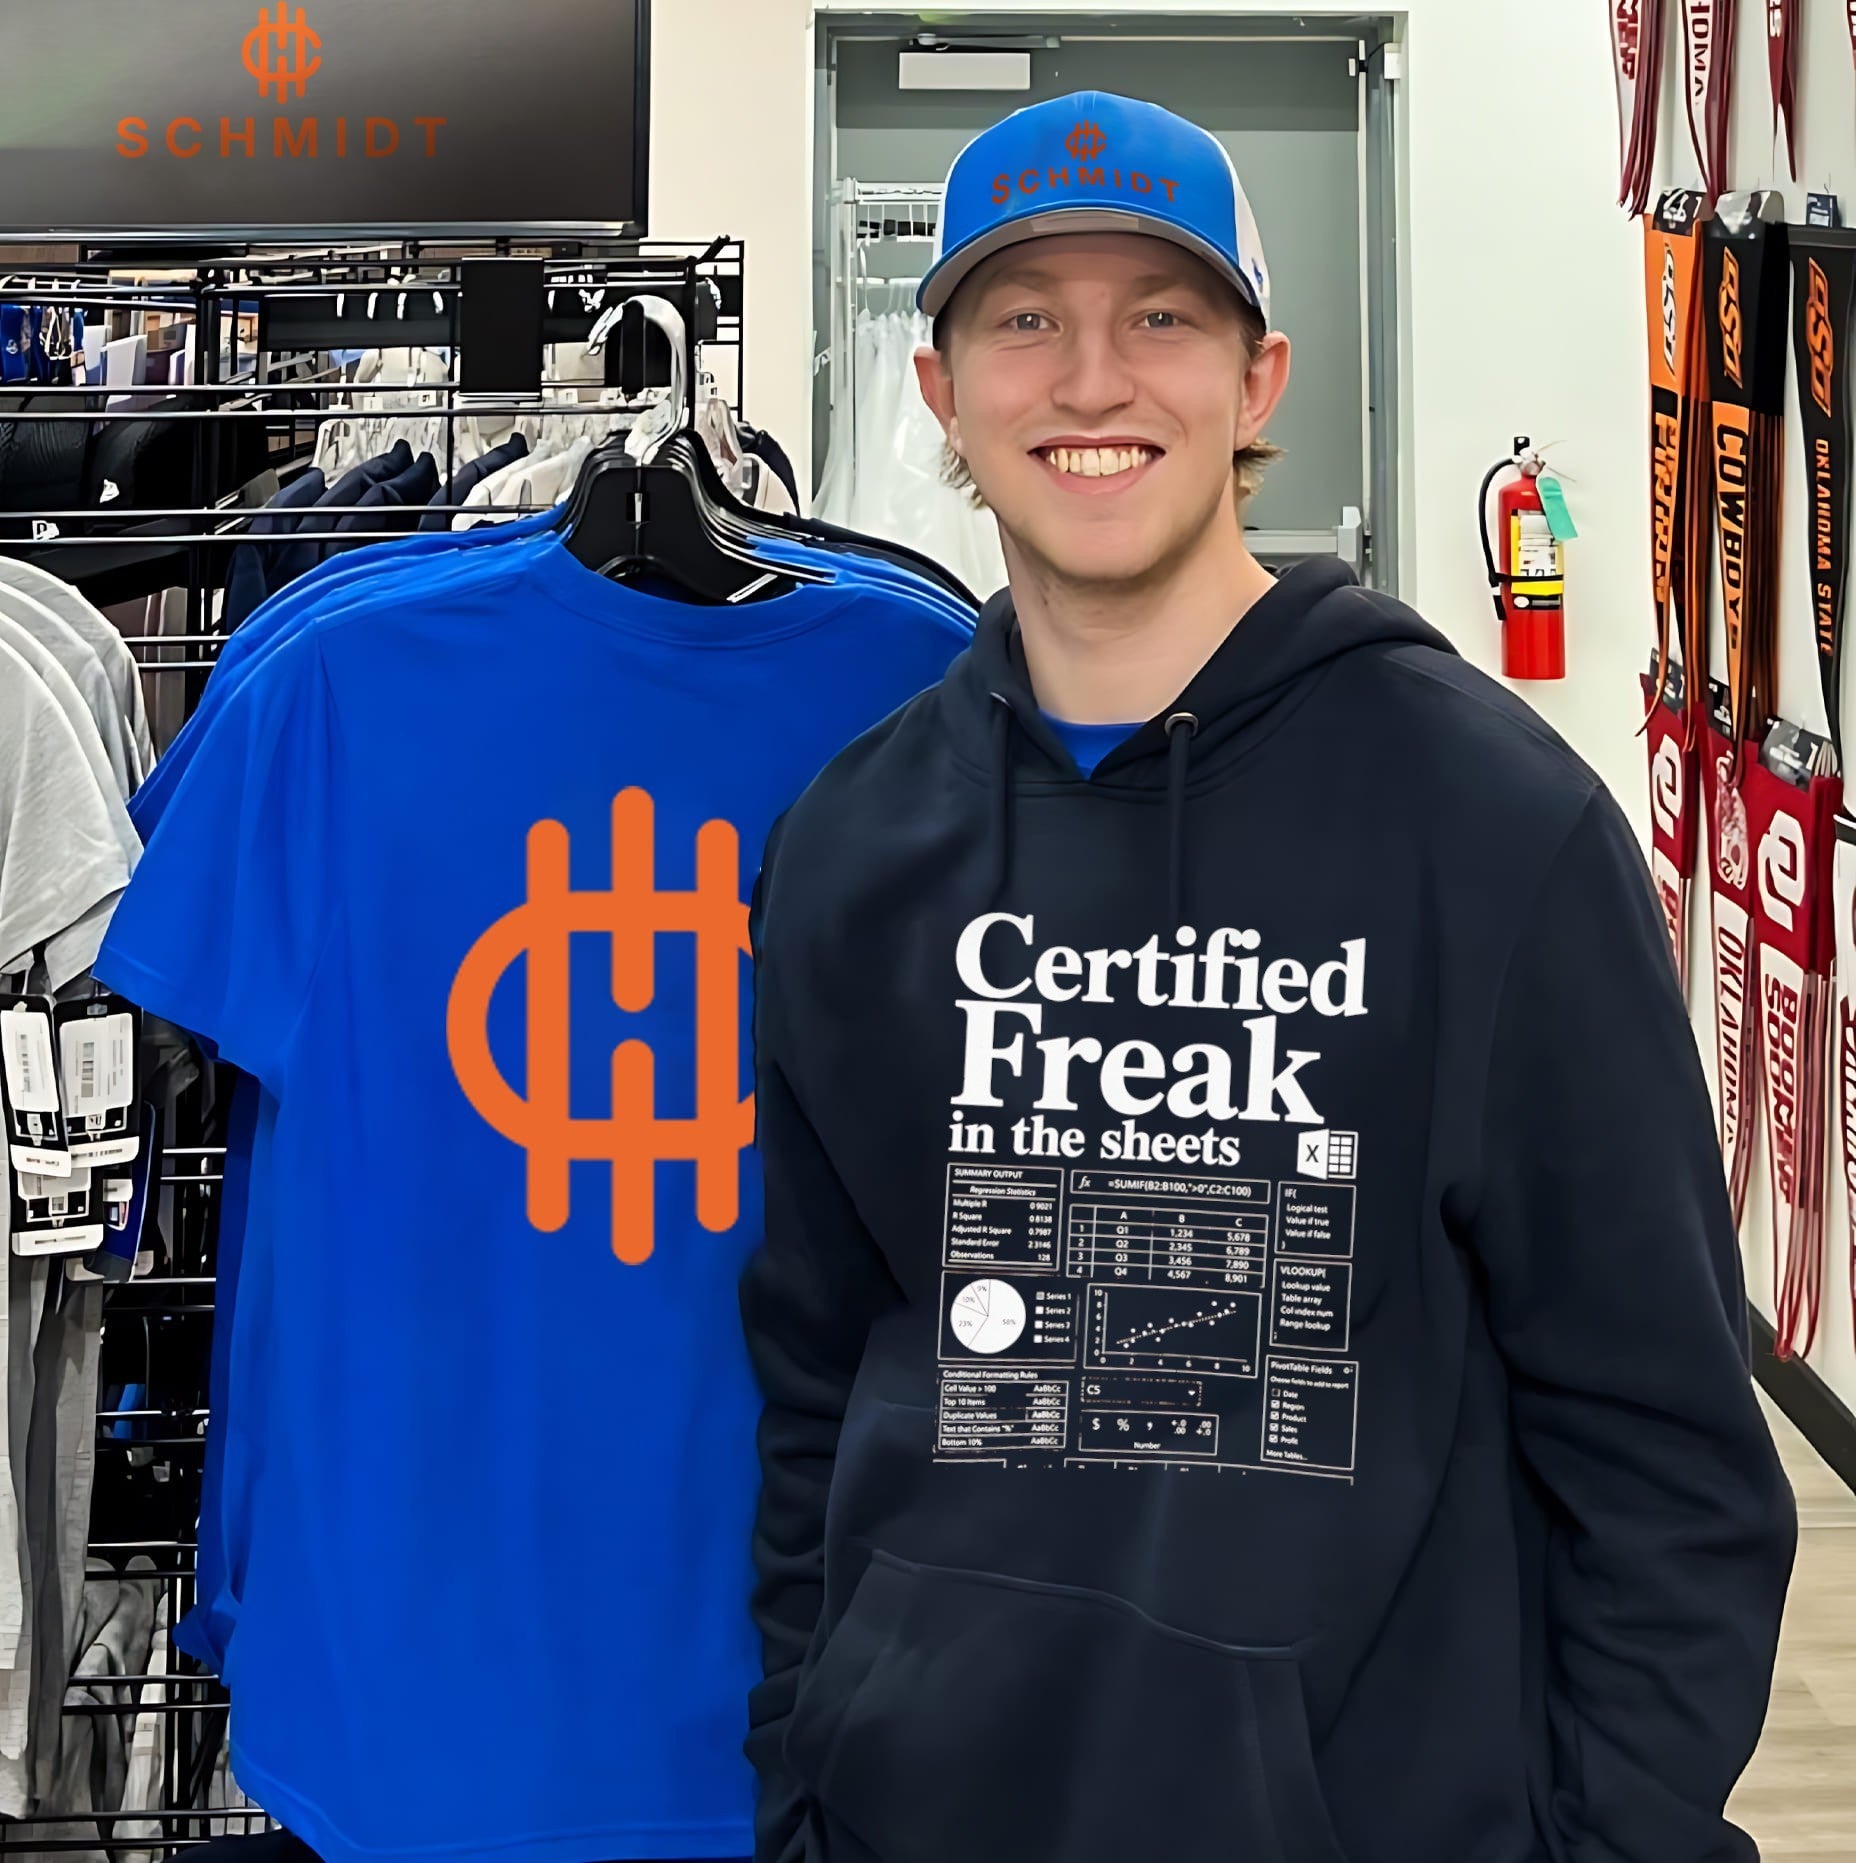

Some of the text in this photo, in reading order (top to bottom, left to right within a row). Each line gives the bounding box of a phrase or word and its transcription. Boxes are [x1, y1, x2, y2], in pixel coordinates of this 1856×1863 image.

[116, 116, 448, 158] SCHMIDT
[992, 167, 1179, 205] SCHMIDT
[1815, 438, 1832, 570] OKLAHOMA
[956, 912, 1369, 1017] Certified
[950, 1000, 1325, 1124] Freak
[948, 1111, 1240, 1167] in the sheets
[1305, 1144, 1319, 1163] X
[954, 1168, 1023, 1179] SUMMARY OUTPUT
[1078, 1176, 1091, 1189] fx
[970, 1185, 1036, 1196] Regression Statistics
[1285, 1188, 1297, 1199] IF(
[953, 1199, 980, 1207] Multiple
[1286, 1203, 1328, 1214] Logical test
[959, 1212, 982, 1221] Square
[1120, 1211, 1243, 1227] A B C
[1286, 1216, 1306, 1225] Value
[1314, 1218, 1330, 1226] true
[951, 1224, 981, 1234] Adjusted
[989, 1226, 1012, 1235] Square
[1116, 1226, 1129, 1235] Q1
[1285, 1229, 1306, 1238] Value
[1313, 1230, 1331, 1239] false
[951, 1238, 981, 1246] Standard
[1078, 1238, 1084, 1247] 2
[1116, 1240, 1129, 1249] Q2
[950, 1250, 994, 1259] Observations
[1078, 1252, 1084, 1261] 3
[1115, 1253, 1128, 1263] Q3
[1077, 1266, 1083, 1274] 4
[1114, 1267, 1127, 1277] Q4
[1281, 1281, 1331, 1292] Lookup value
[1046, 1292, 1066, 1300] Series
[1281, 1293, 1322, 1306] Table array
[1045, 1306, 1065, 1315] Series
[1280, 1305, 1294, 1314] Col
[1294, 1307, 1315, 1316] index
[1044, 1320, 1065, 1329] Series
[1280, 1318, 1331, 1331] Range lookup
[1043, 1335, 1064, 1343] Series
[1270, 1360, 1333, 1375] PivotTable Fields
[943, 1370, 1038, 1380] Conditional Formatting Rules
[959, 1385, 977, 1393] Value
[984, 1385, 997, 1393] 100
[1283, 1390, 1299, 1399] Date
[944, 1398, 956, 1406] Top
[943, 1412, 997, 1420] Duplicate Values
[1282, 1413, 1307, 1423] Product
[943, 1425, 956, 1433] Text
[957, 1425, 971, 1433] that
[972, 1425, 1001, 1433] Contains
[1117, 1418, 1130, 1431] %
[1281, 1425, 1298, 1433] Sales
[941, 1438, 967, 1446] Bottom
[1133, 1442, 1161, 1450] Number
[1266, 1449, 1283, 1458] More
